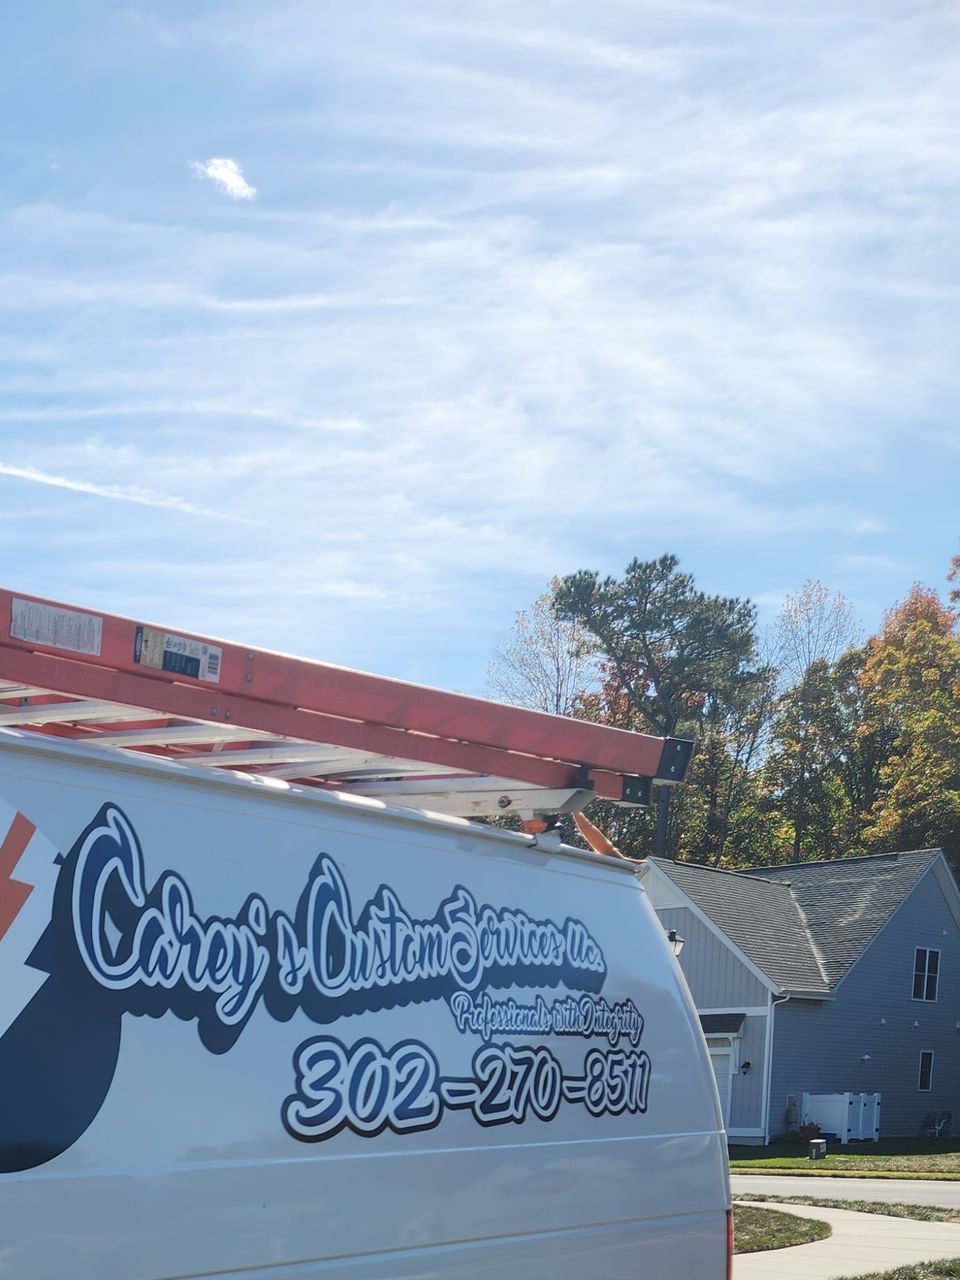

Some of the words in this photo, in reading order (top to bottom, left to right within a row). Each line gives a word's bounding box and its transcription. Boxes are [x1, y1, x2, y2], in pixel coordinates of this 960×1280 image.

[71, 806, 311, 1026] Carey's
[306, 857, 451, 998] Custom
[444, 888, 566, 991] Services
[451, 991, 552, 1041] Professionals
[552, 1000, 584, 1033] with
[580, 996, 643, 1045] Integrity
[285, 1040, 648, 1138] 302-270-8511
